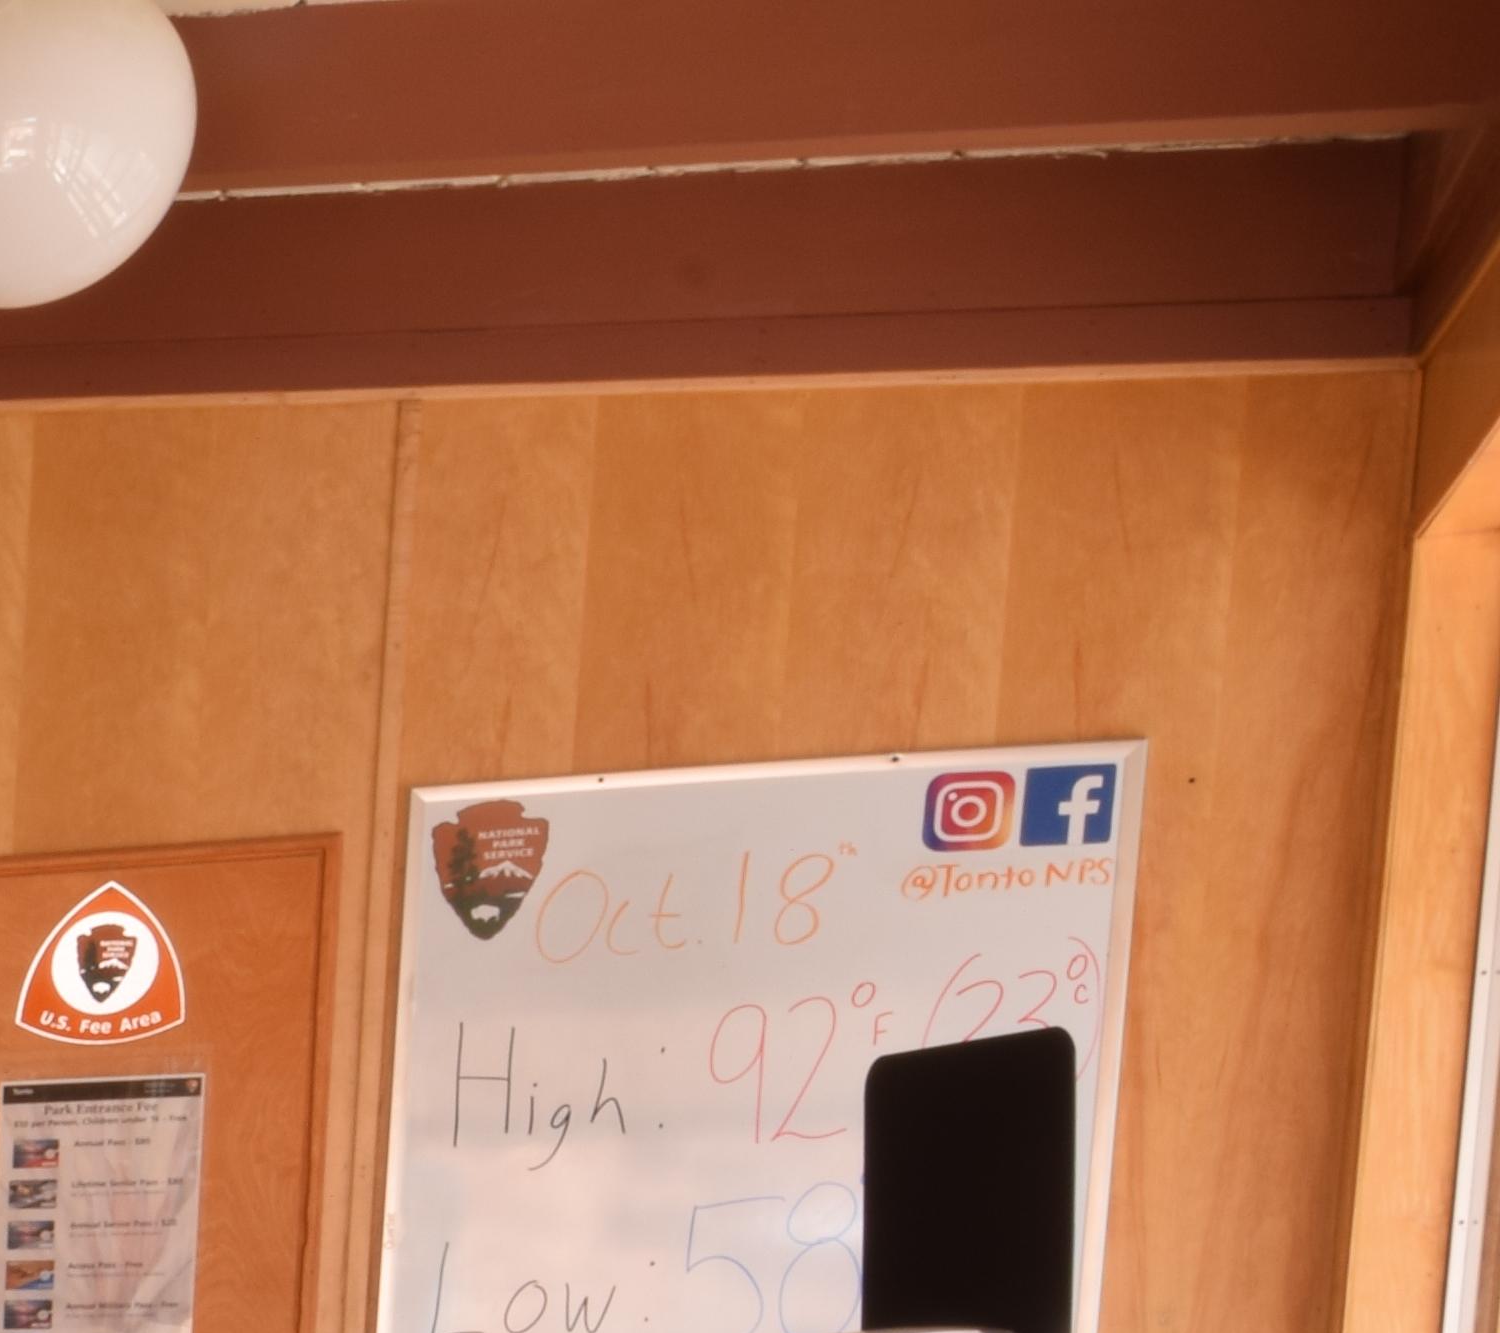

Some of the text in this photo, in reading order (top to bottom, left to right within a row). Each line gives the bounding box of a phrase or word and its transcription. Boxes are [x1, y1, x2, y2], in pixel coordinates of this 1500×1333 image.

[477, 825, 542, 840] NATIONAL
[492, 837, 525, 850] PARK
[483, 846, 535, 861] SERVICE
[534, 869, 703, 963] Oct.
[40, 1010, 162, 1034] U.S. Fee Area
[43, 1101, 159, 1116] Park Entrance Fee
